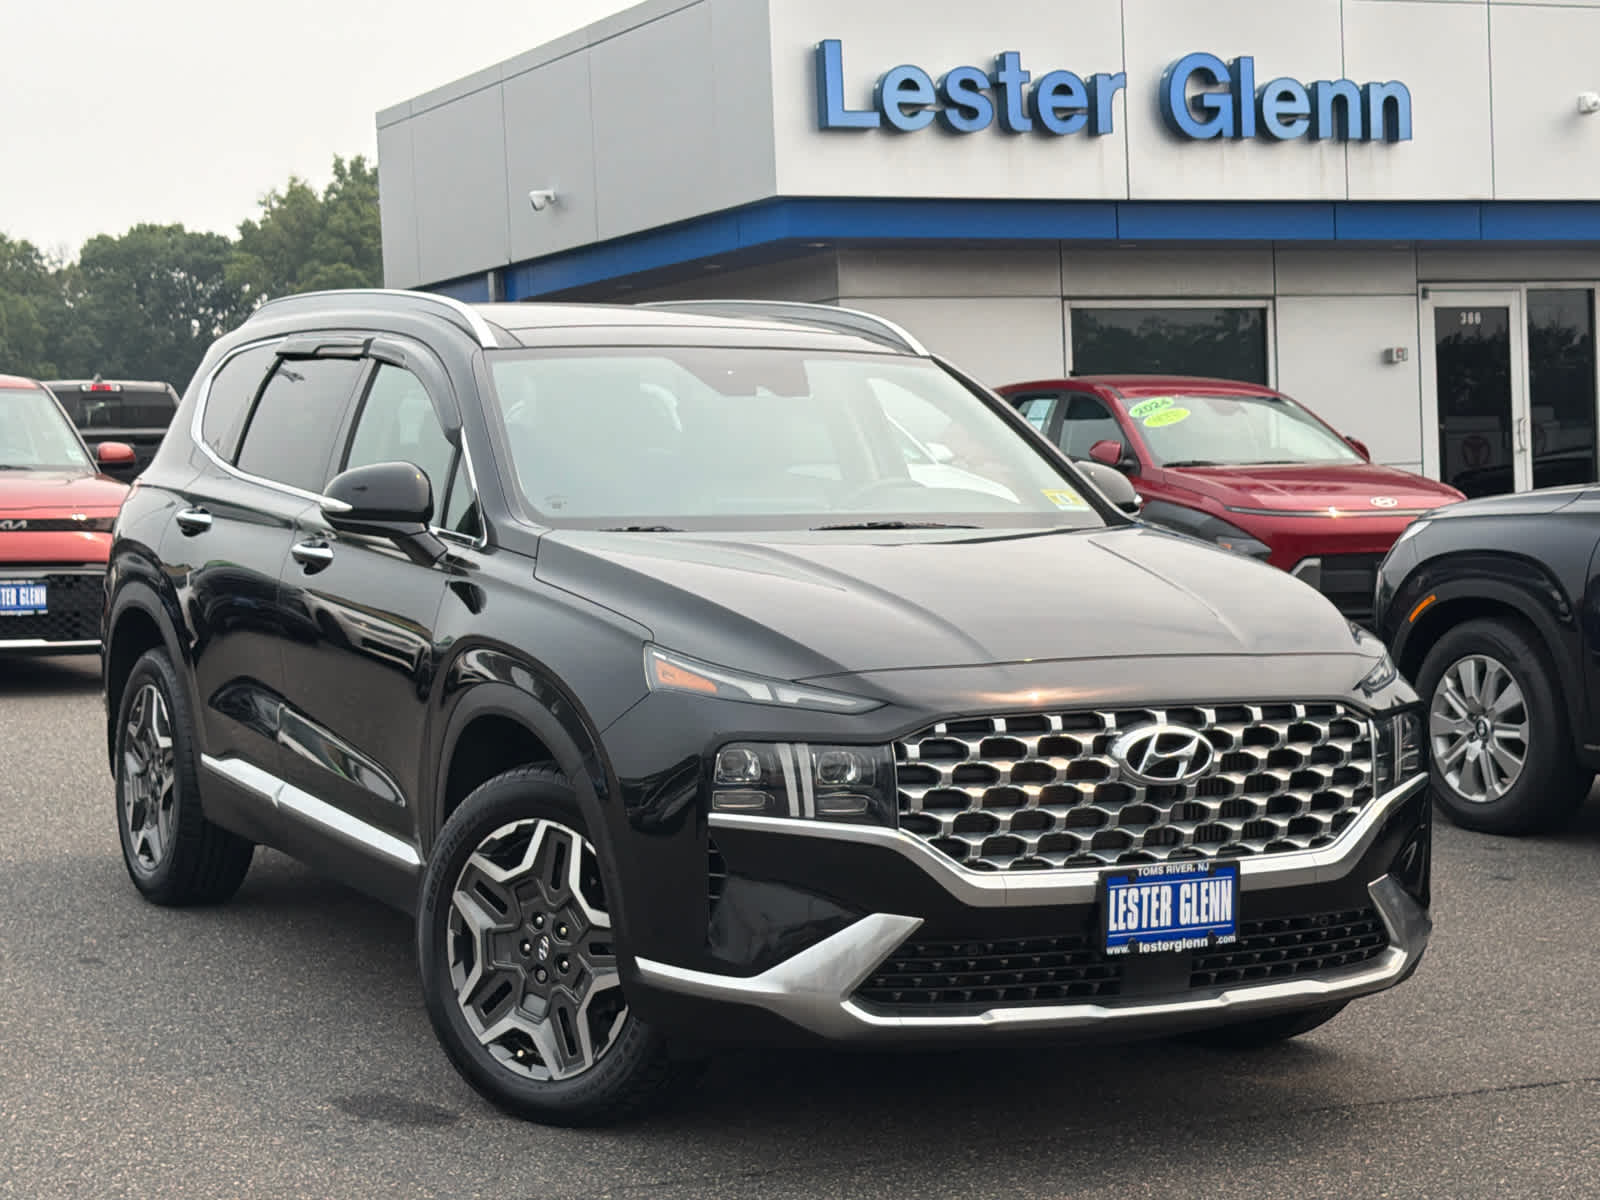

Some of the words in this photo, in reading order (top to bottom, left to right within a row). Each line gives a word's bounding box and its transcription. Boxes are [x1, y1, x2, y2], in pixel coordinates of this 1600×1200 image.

[815, 39, 1127, 136] Lester
[1159, 52, 1413, 143] Glenn
[19, 585, 46, 606] GLENN
[1137, 866, 1164, 877] TOMS
[1197, 862, 1210, 873] NJ
[1108, 885, 1172, 932] LESTER
[1179, 880, 1233, 926] GLENN
[1138, 937, 1209, 954] lesterglenn
